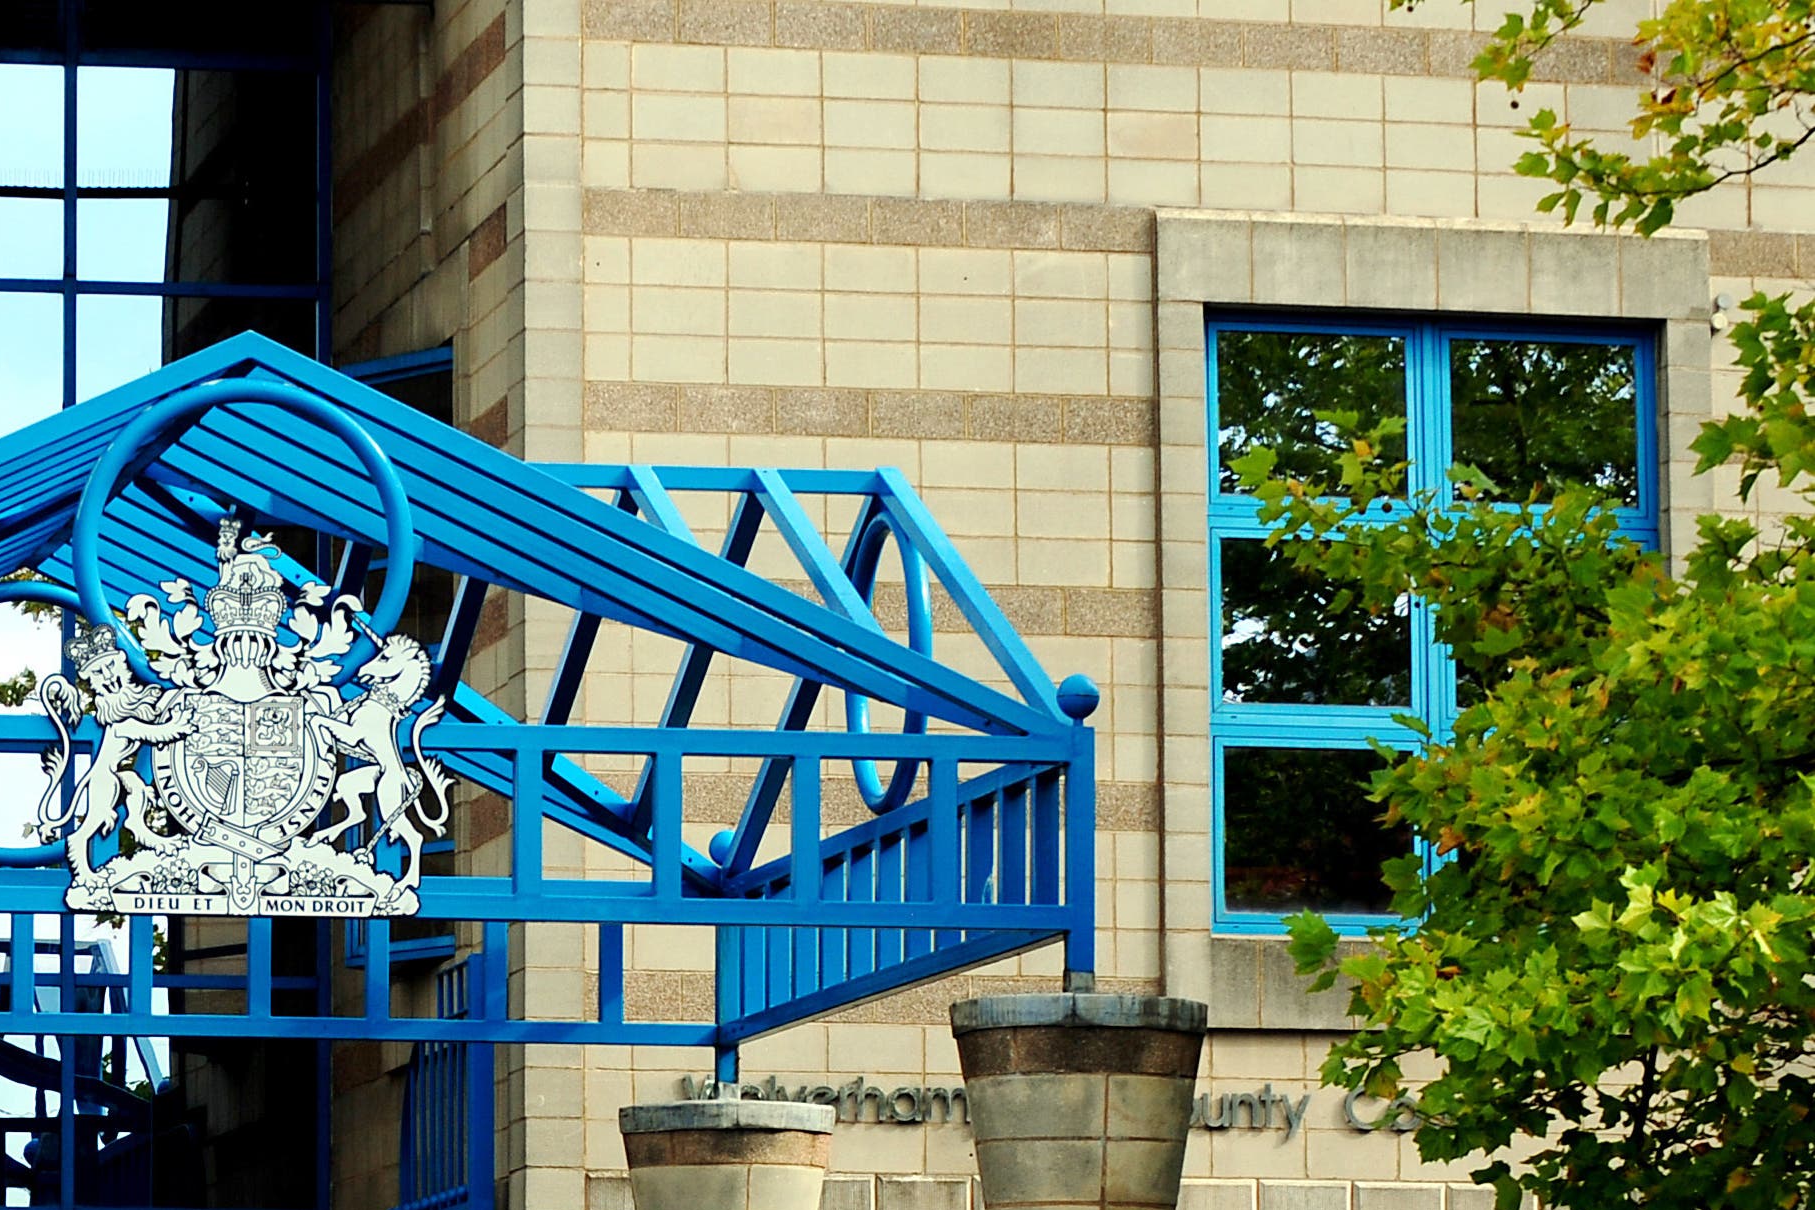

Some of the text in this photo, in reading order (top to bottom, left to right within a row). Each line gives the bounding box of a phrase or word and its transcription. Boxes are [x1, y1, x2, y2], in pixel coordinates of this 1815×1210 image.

[157, 764, 195, 823] HONI
[274, 775, 329, 838] PENSE
[134, 898, 212, 911] DIEU ET
[265, 900, 366, 913] MON DROIT
